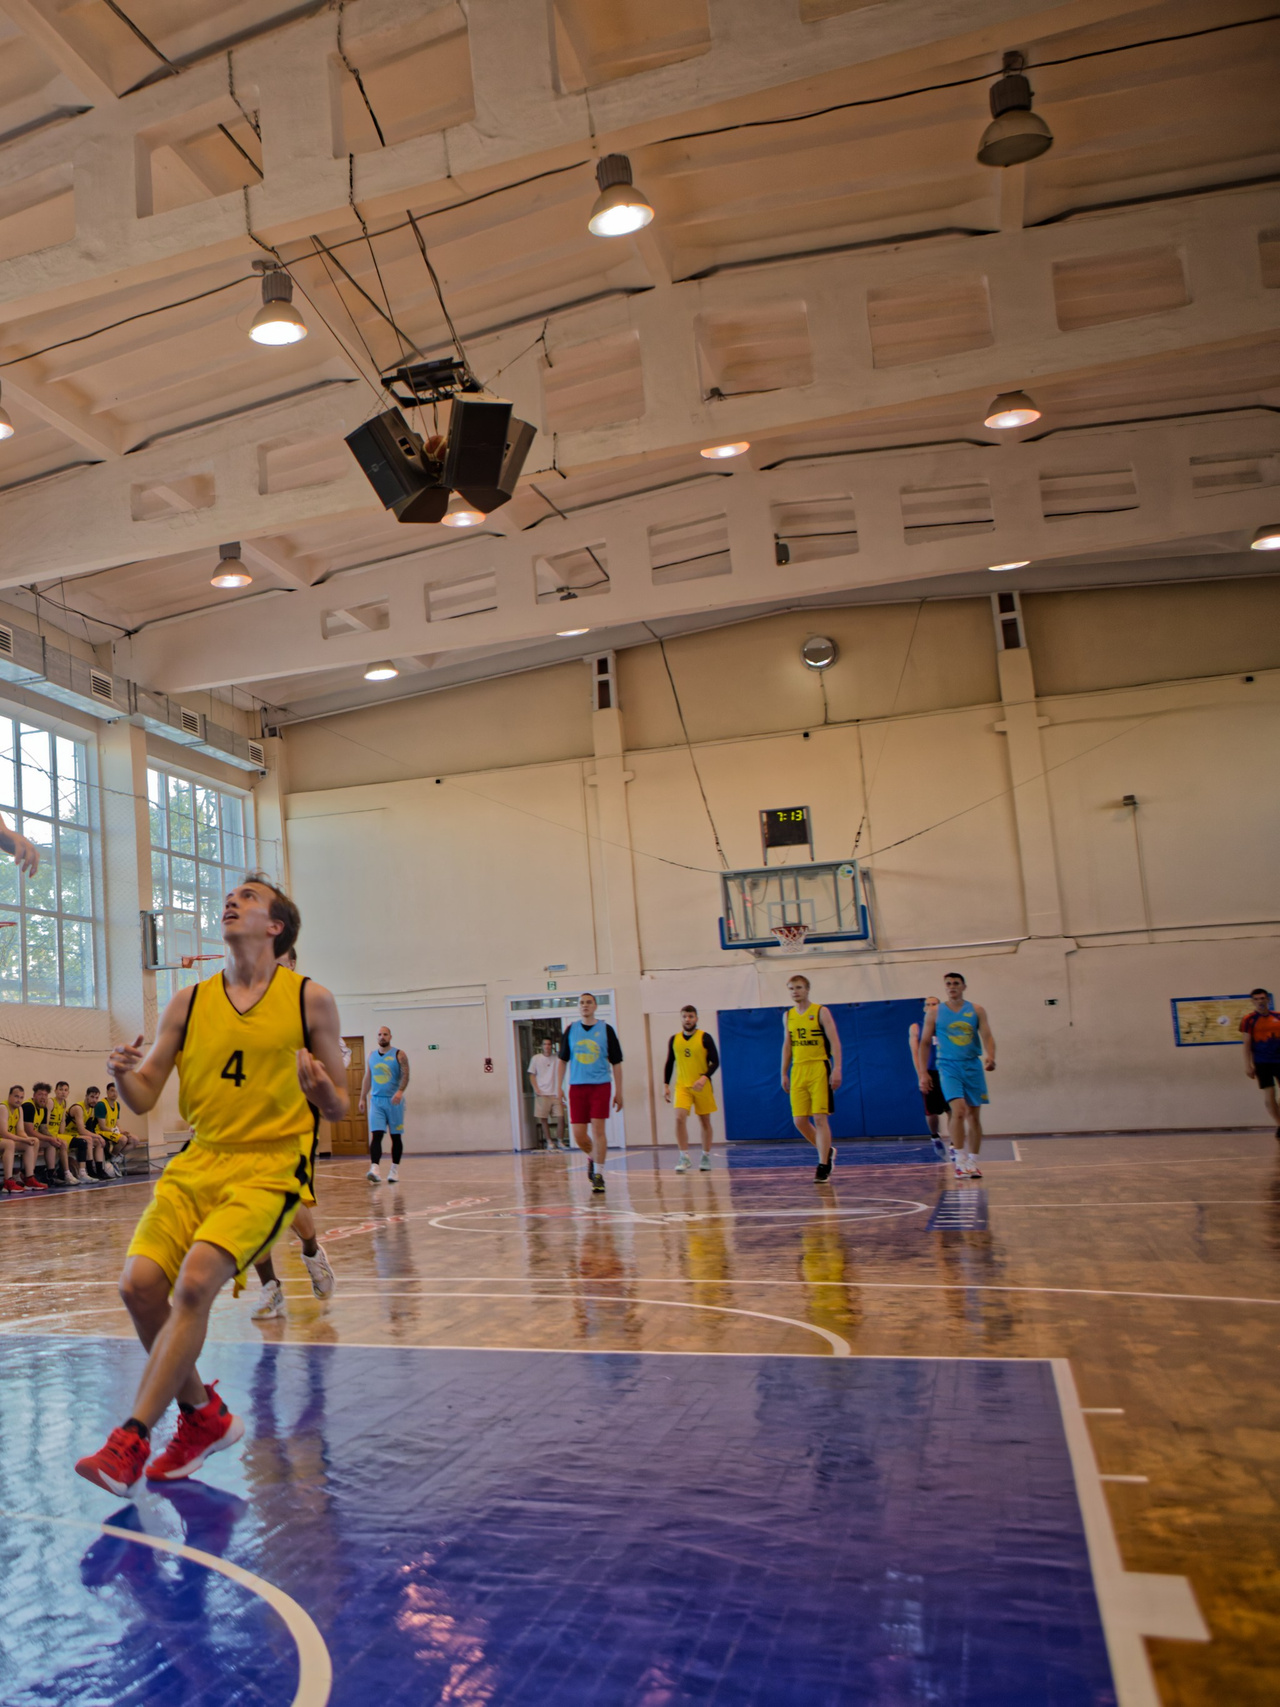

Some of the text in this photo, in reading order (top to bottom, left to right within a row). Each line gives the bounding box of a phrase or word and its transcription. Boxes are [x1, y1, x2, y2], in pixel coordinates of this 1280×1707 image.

[776, 810, 803, 822] 7:13
[796, 1028, 807, 1039] 12
[221, 1050, 246, 1087] 4
